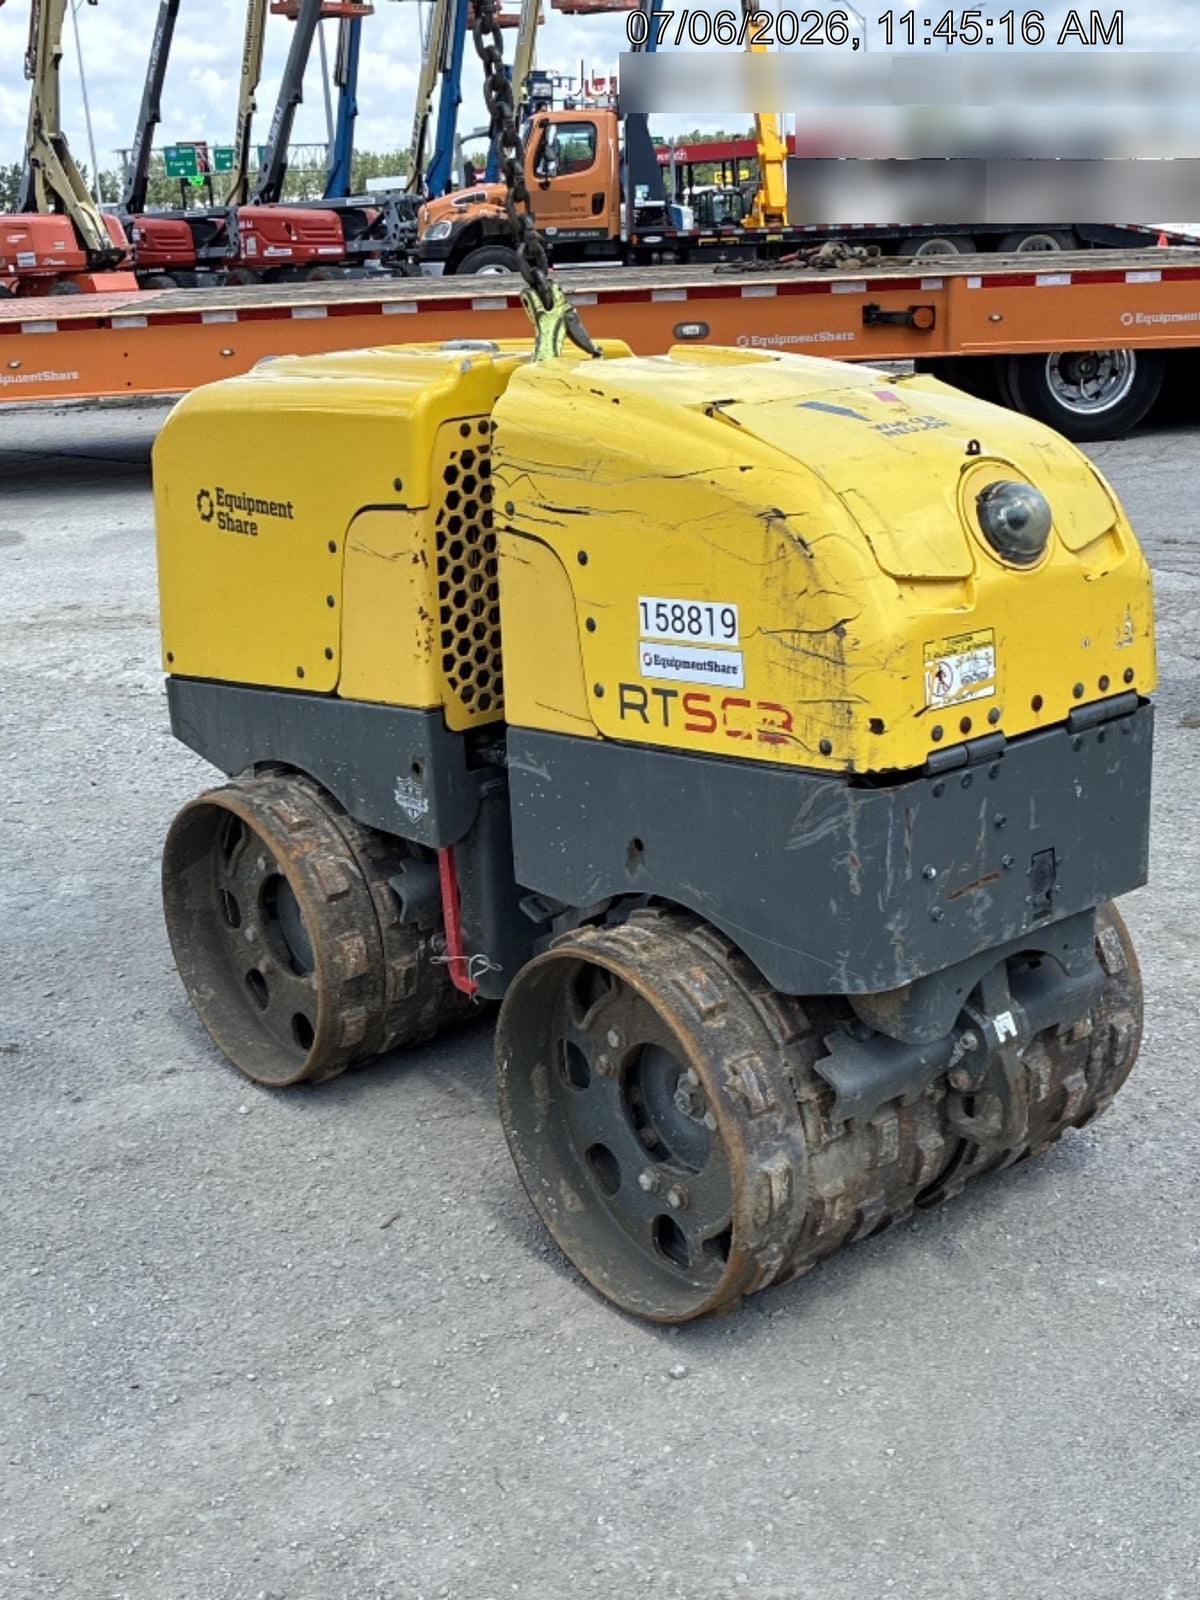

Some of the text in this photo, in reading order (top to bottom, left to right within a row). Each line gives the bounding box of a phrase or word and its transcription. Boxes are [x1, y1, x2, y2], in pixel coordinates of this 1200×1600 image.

[751, 331, 856, 348] EquipmentShare
[215, 486, 295, 520] Equipment
[217, 510, 259, 536] Share
[639, 602, 737, 639] 158819
[653, 653, 739, 675] EquipmentShare
